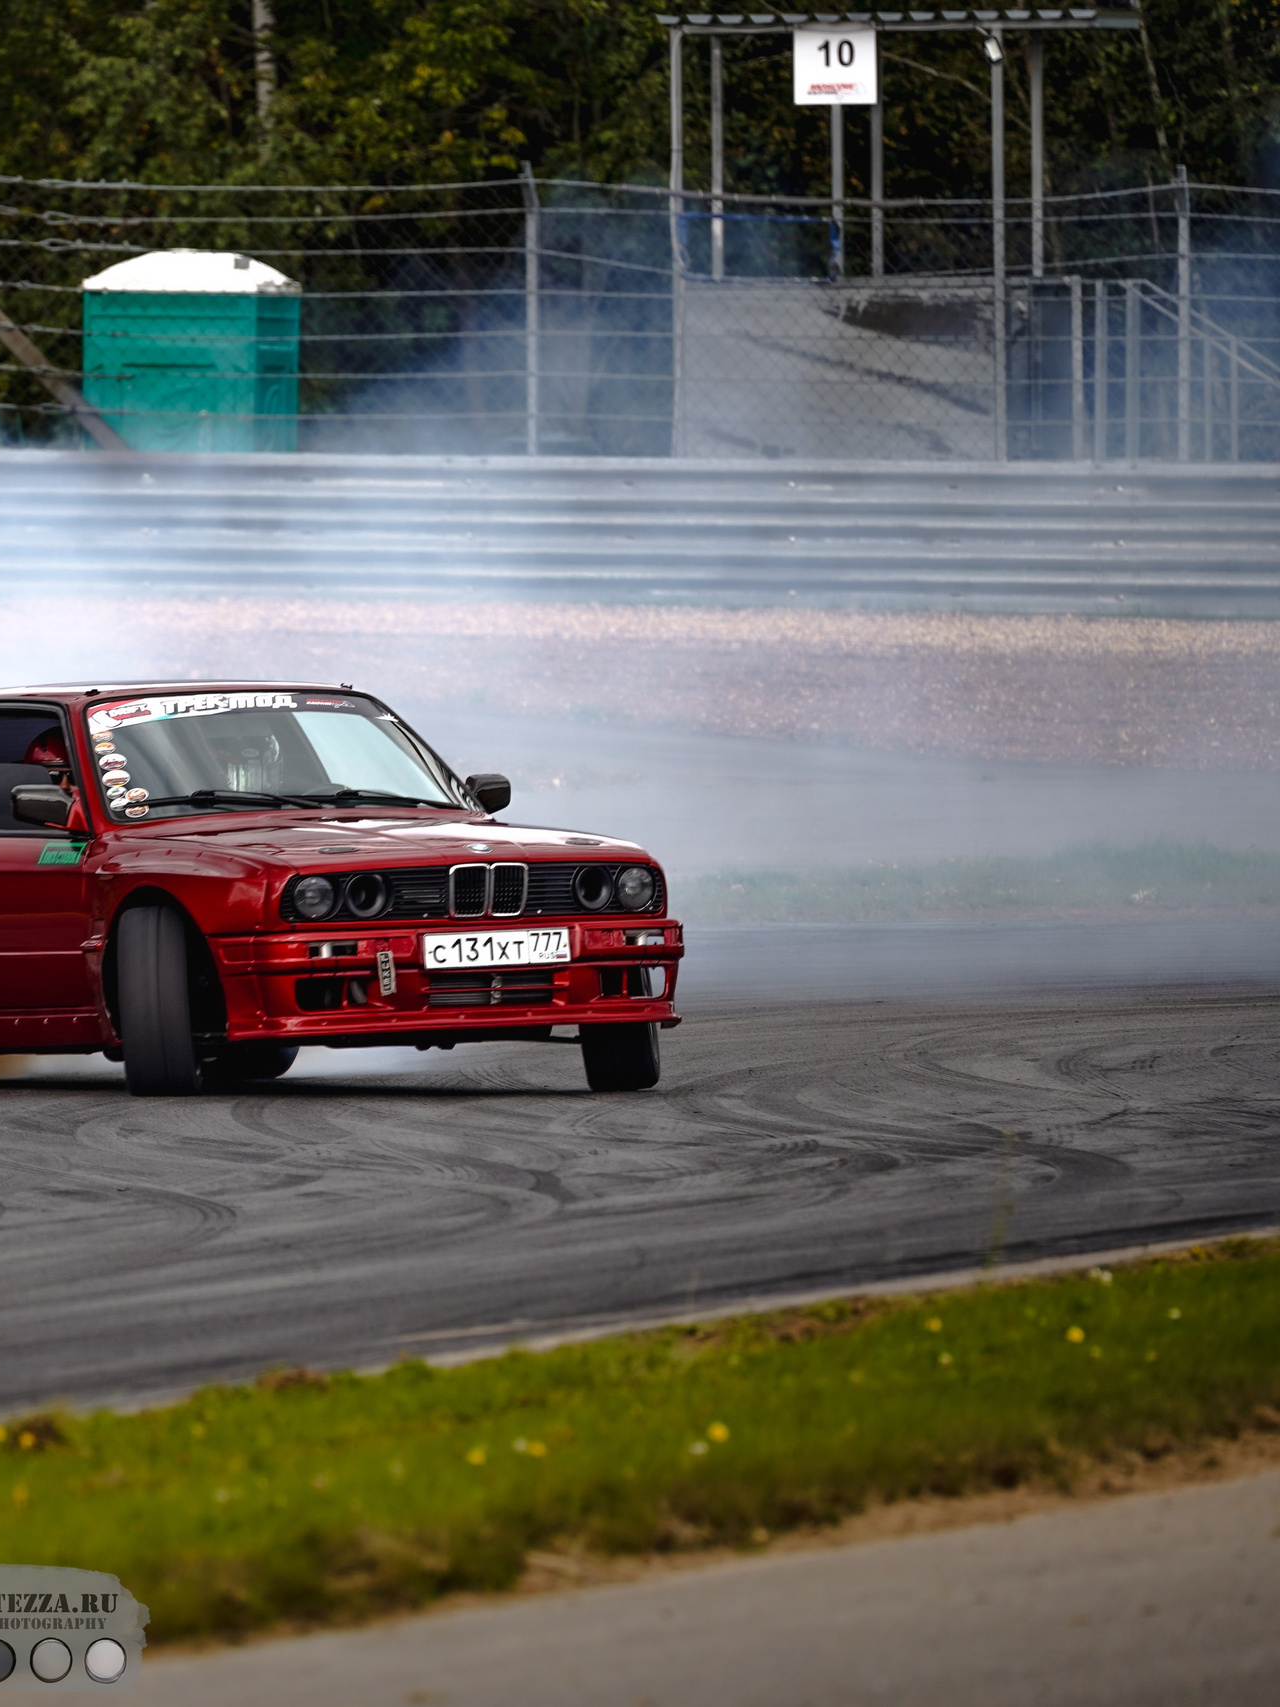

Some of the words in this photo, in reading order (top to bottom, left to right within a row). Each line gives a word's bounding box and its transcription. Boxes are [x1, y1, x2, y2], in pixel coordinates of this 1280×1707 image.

[818, 40, 855, 67] 10
[530, 931, 562, 952] 777
[539, 952, 555, 960] RUS
